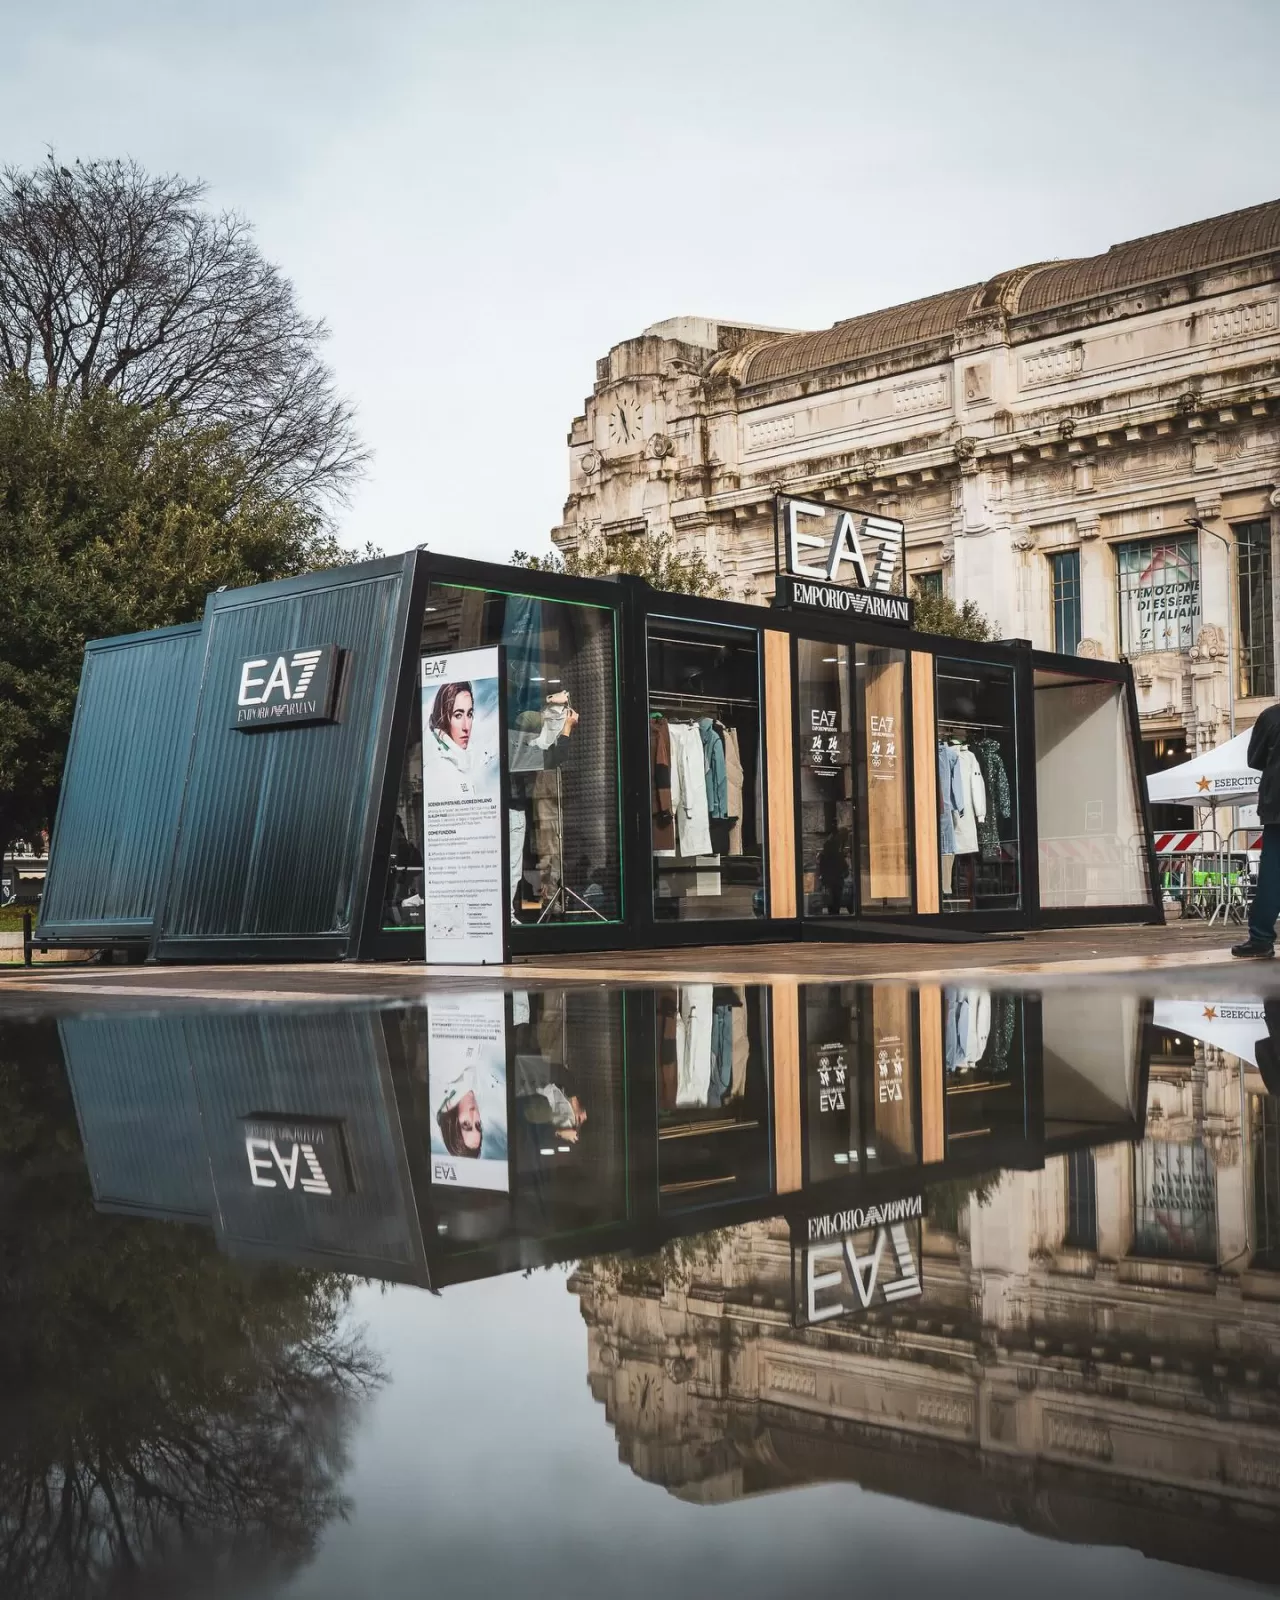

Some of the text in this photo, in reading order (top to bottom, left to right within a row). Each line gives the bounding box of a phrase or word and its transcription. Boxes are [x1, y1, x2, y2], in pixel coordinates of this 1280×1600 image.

[785, 500, 905, 592] EA7
[1128, 580, 1200, 600] L'EMOZIONE
[793, 583, 909, 621] EMPORIO ARMANI
[1137, 594, 1198, 611] DI ESSERE
[1147, 605, 1201, 622] ITALIANI
[425, 660, 447, 676] EA7
[238, 650, 322, 706] EA7
[237, 700, 316, 722] EMPORIO ARMANI
[811, 709, 837, 727] EA7
[870, 715, 894, 733] EA7
[1214, 776, 1261, 788] ESERCITO
